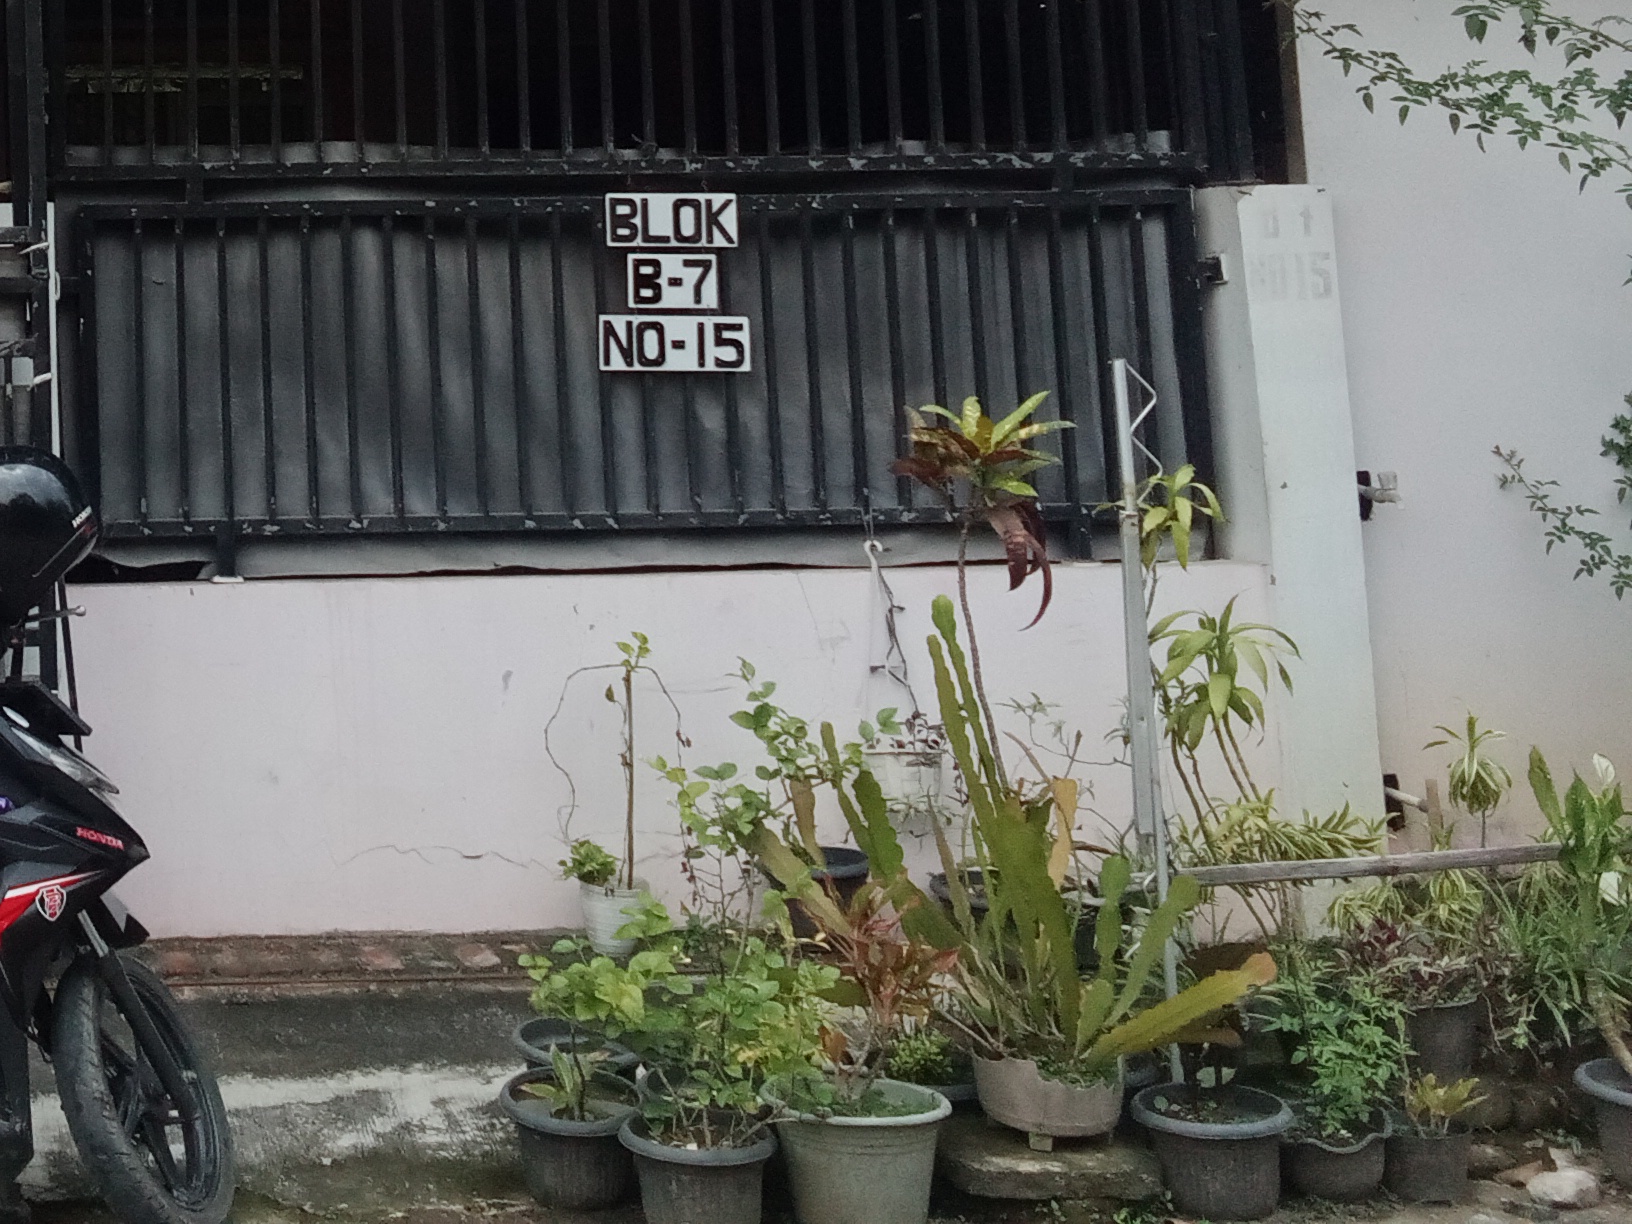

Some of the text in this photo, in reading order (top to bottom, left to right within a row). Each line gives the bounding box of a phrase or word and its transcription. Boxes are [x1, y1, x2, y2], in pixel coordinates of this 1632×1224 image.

[608, 197, 736, 245] BLOK
[632, 258, 713, 305] B-7
[602, 319, 746, 369] NO-15
[75, 826, 125, 851] HONDA
